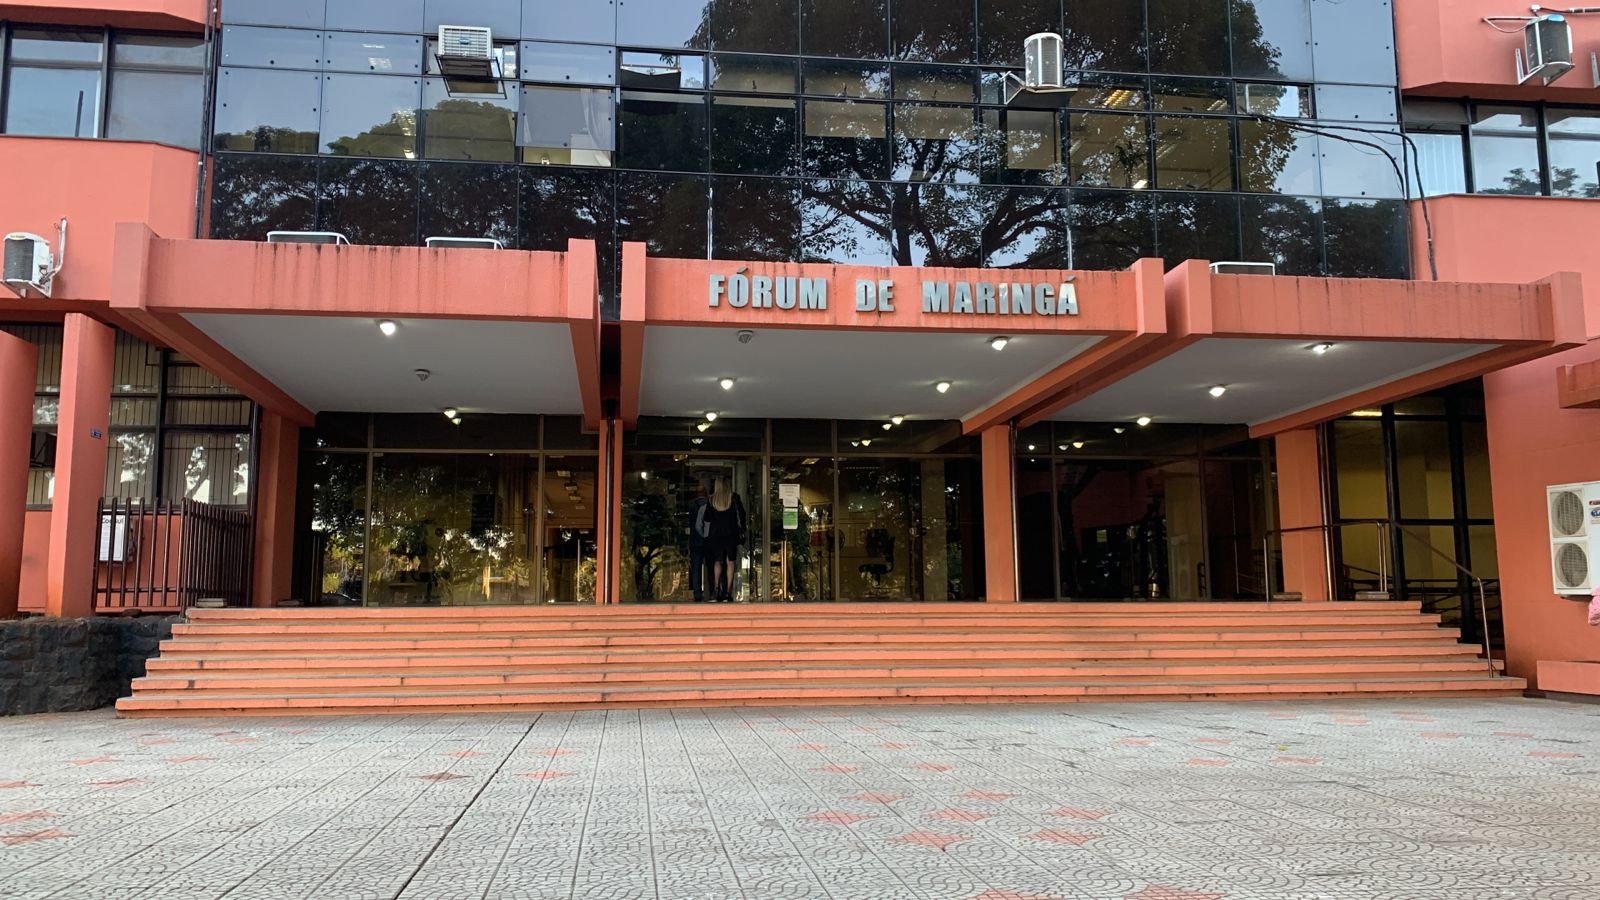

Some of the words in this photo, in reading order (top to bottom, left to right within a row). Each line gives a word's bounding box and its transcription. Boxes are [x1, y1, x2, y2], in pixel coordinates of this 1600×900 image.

[709, 267, 827, 310] FÓRUM
[856, 279, 895, 313] DE
[922, 275, 1079, 316] MARINGÁ
